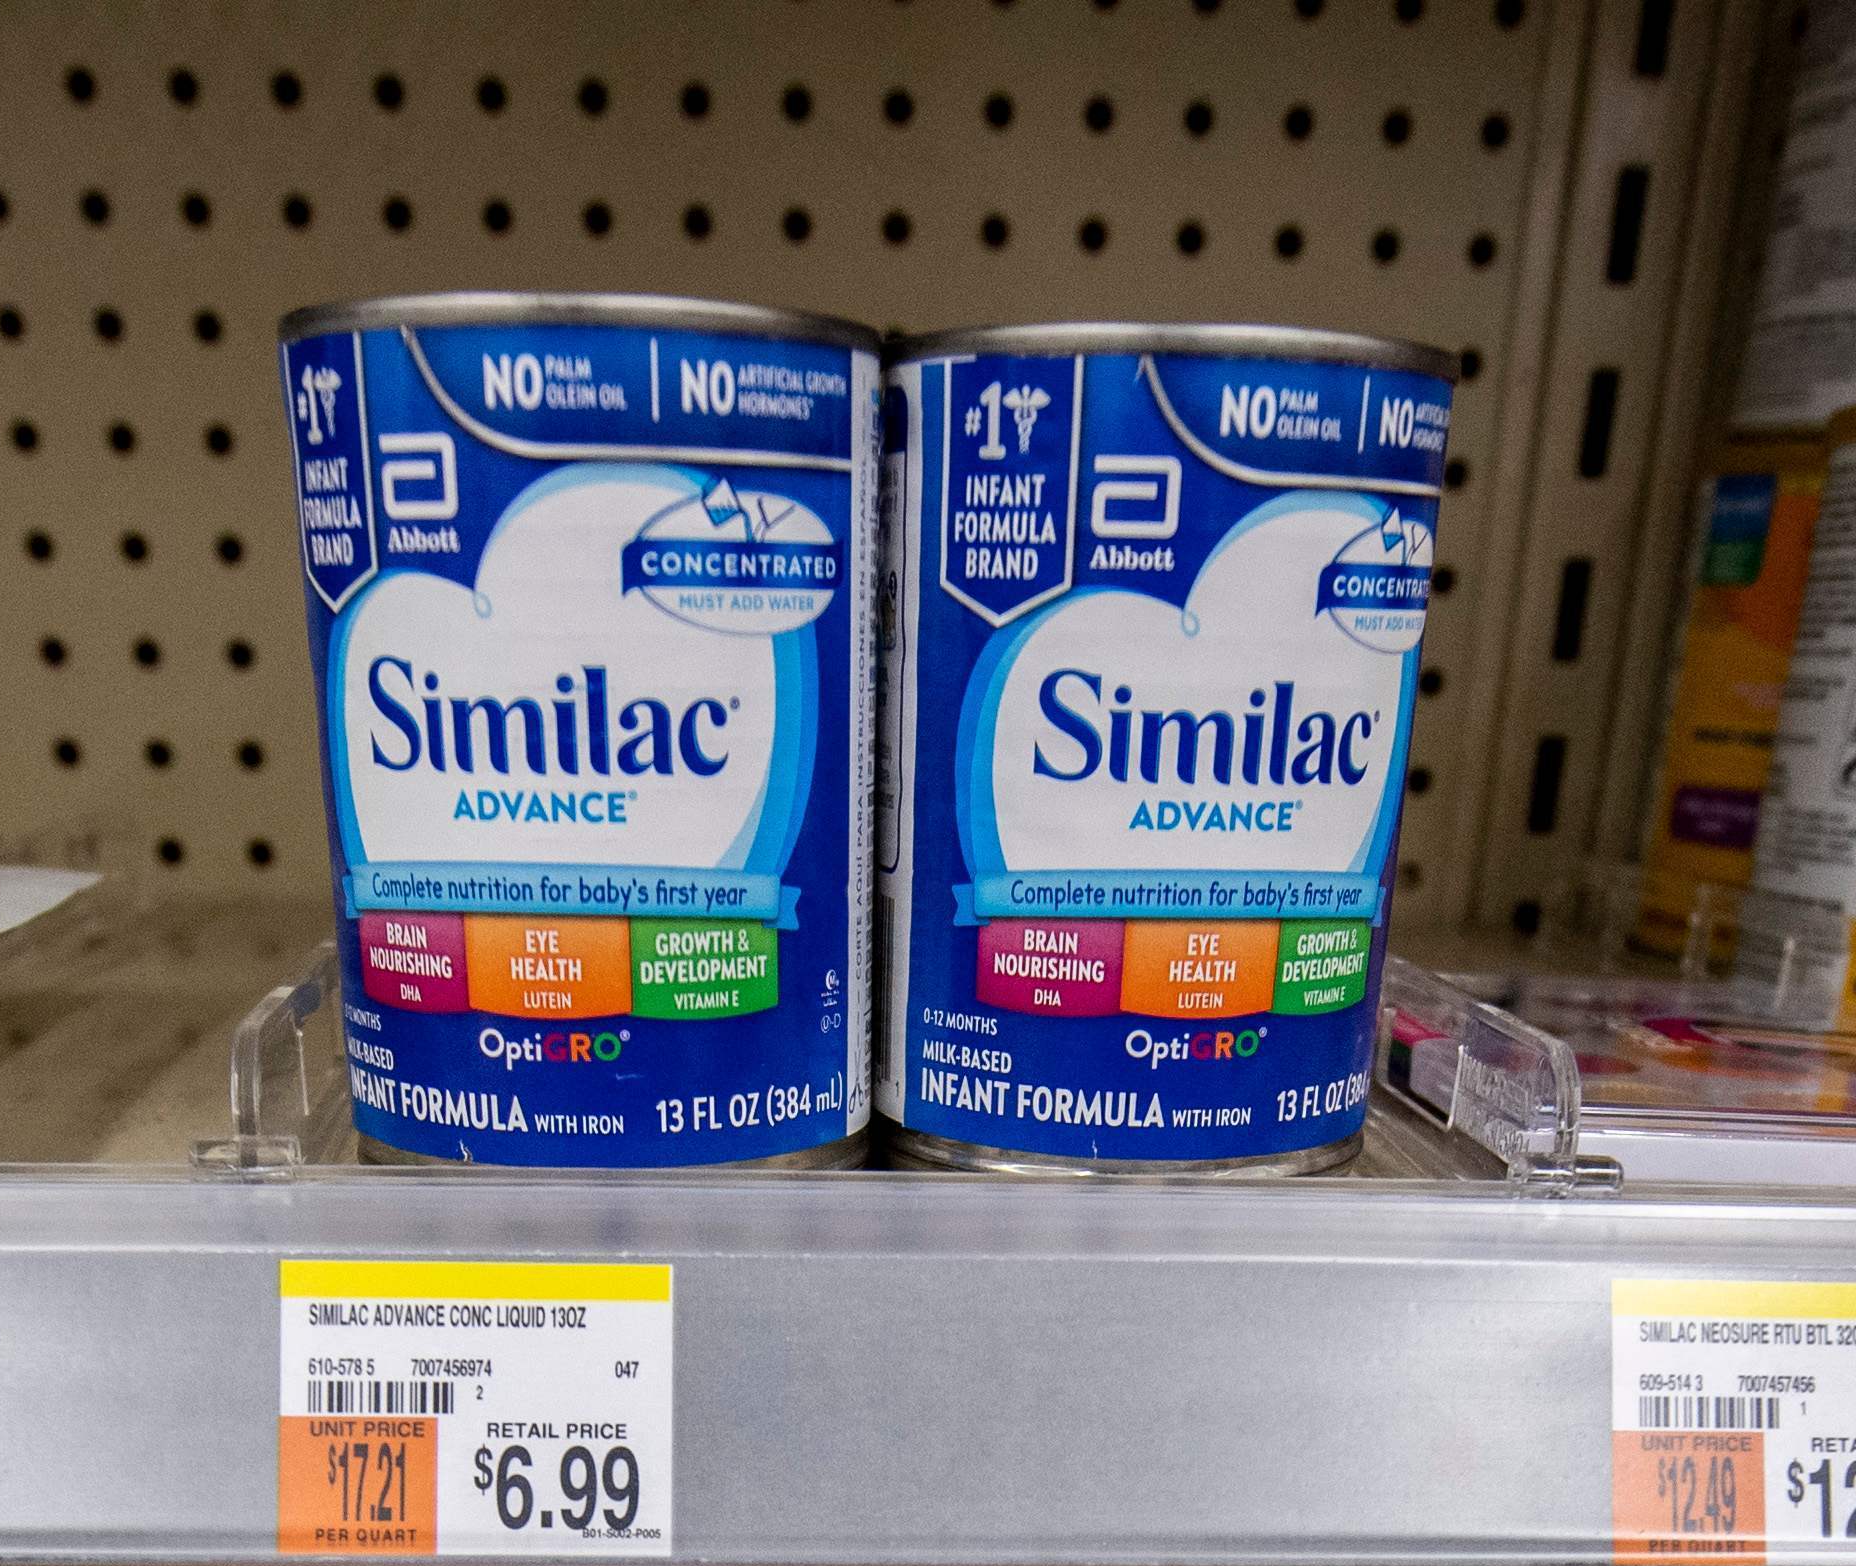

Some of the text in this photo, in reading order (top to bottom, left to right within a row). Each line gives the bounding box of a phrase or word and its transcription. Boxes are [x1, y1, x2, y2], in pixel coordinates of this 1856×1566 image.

[483, 352, 542, 411] NO
[544, 355, 592, 380] PALM
[681, 359, 735, 416] NO
[964, 381, 1006, 460] #1
[1220, 383, 1277, 439] NO
[1378, 396, 1415, 449] NO
[966, 475, 1045, 505] INFANT
[388, 526, 460, 553] Abbott
[954, 512, 1057, 545] FORMULA
[641, 549, 836, 580] CONCENTRATED
[965, 547, 1039, 580] BRAND
[1089, 544, 1175, 572] Abbott
[679, 592, 814, 612] MUST ADD WATER
[372, 872, 747, 914] Complete nutrition for baby's first year
[1011, 879, 1362, 914] Complete nutrition for baby's first year
[386, 922, 427, 949] BRAIN
[525, 928, 559, 954] EYE
[655, 929, 749, 955] GROWTH &
[1023, 929, 1079, 955] BRAIN
[1187, 934, 1220, 957] EYE
[1297, 927, 1358, 956] GROWTH &
[370, 945, 453, 979] NOURISHING
[510, 957, 582, 982] HEALTH
[640, 955, 767, 985] DEVELOPMENT
[855, 934, 864, 980] CORTE
[993, 955, 1105, 984] NOURISHING
[1282, 955, 1363, 984] DEVELOPMENT
[1168, 960, 1237, 984] HEALTH
[400, 983, 422, 1003] DHA
[523, 991, 572, 1009] LUTEIN
[674, 990, 739, 1010] VITAMIN E
[1033, 988, 1062, 1007] DHA
[1177, 992, 1223, 1010] LUTEIN
[923, 1009, 998, 1037] 0-12 MONTHS
[922, 1037, 1012, 1075] MILK-BASED
[351, 1064, 624, 1134] INFANT FORMULA WITH IRON
[655, 1072, 843, 1133] 13 FL OZ (384 mL)
[920, 1068, 1252, 1129] INFANT FORMULA WITH IRON
[1276, 1078, 1344, 1122] 13 FL OZ
[309, 1304, 369, 1326] SIMILAC
[374, 1305, 445, 1326] ADVANCE
[449, 1306, 492, 1327] CONC
[496, 1306, 546, 1329] LIQUID
[1639, 1321, 1696, 1343] SIMILAC
[1701, 1322, 1769, 1344] NEOSURE
[1774, 1323, 1802, 1344] RTU
[1806, 1323, 1832, 1345] BTL
[308, 1358, 492, 1377] 610-578 7007456974
[309, 1422, 425, 1438] UNIT PRICE
[486, 1423, 628, 1440] RETAIL PRICE
[328, 1442, 406, 1522] $17.21
[473, 1444, 640, 1531] $6.99
[315, 1528, 417, 1544] PER QUART
